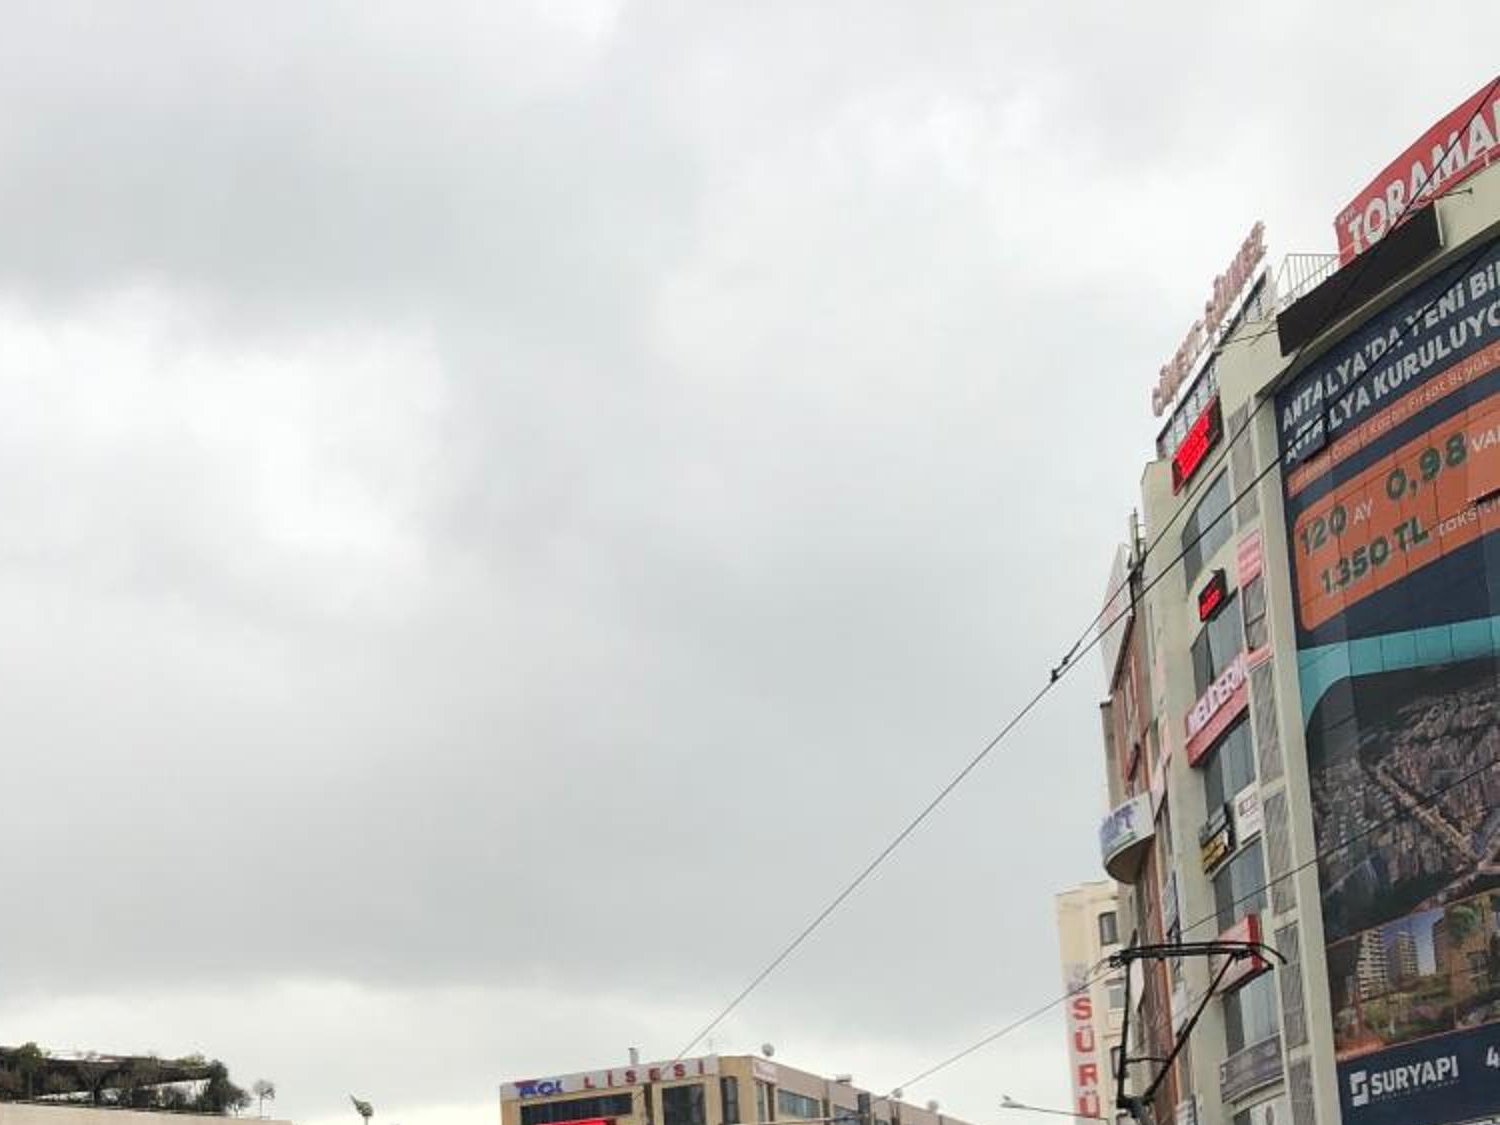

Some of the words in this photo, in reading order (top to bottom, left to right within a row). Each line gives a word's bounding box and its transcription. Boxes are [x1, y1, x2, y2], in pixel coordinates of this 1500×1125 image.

[1348, 98, 1500, 254] TORAMA
[1283, 326, 1403, 431] ANTALYA'DA
[1385, 431, 1468, 500] 0,98
[1471, 425, 1500, 452] VA
[1393, 516, 1430, 552] TL
[1371, 1055, 1460, 1096] SURYAPI
